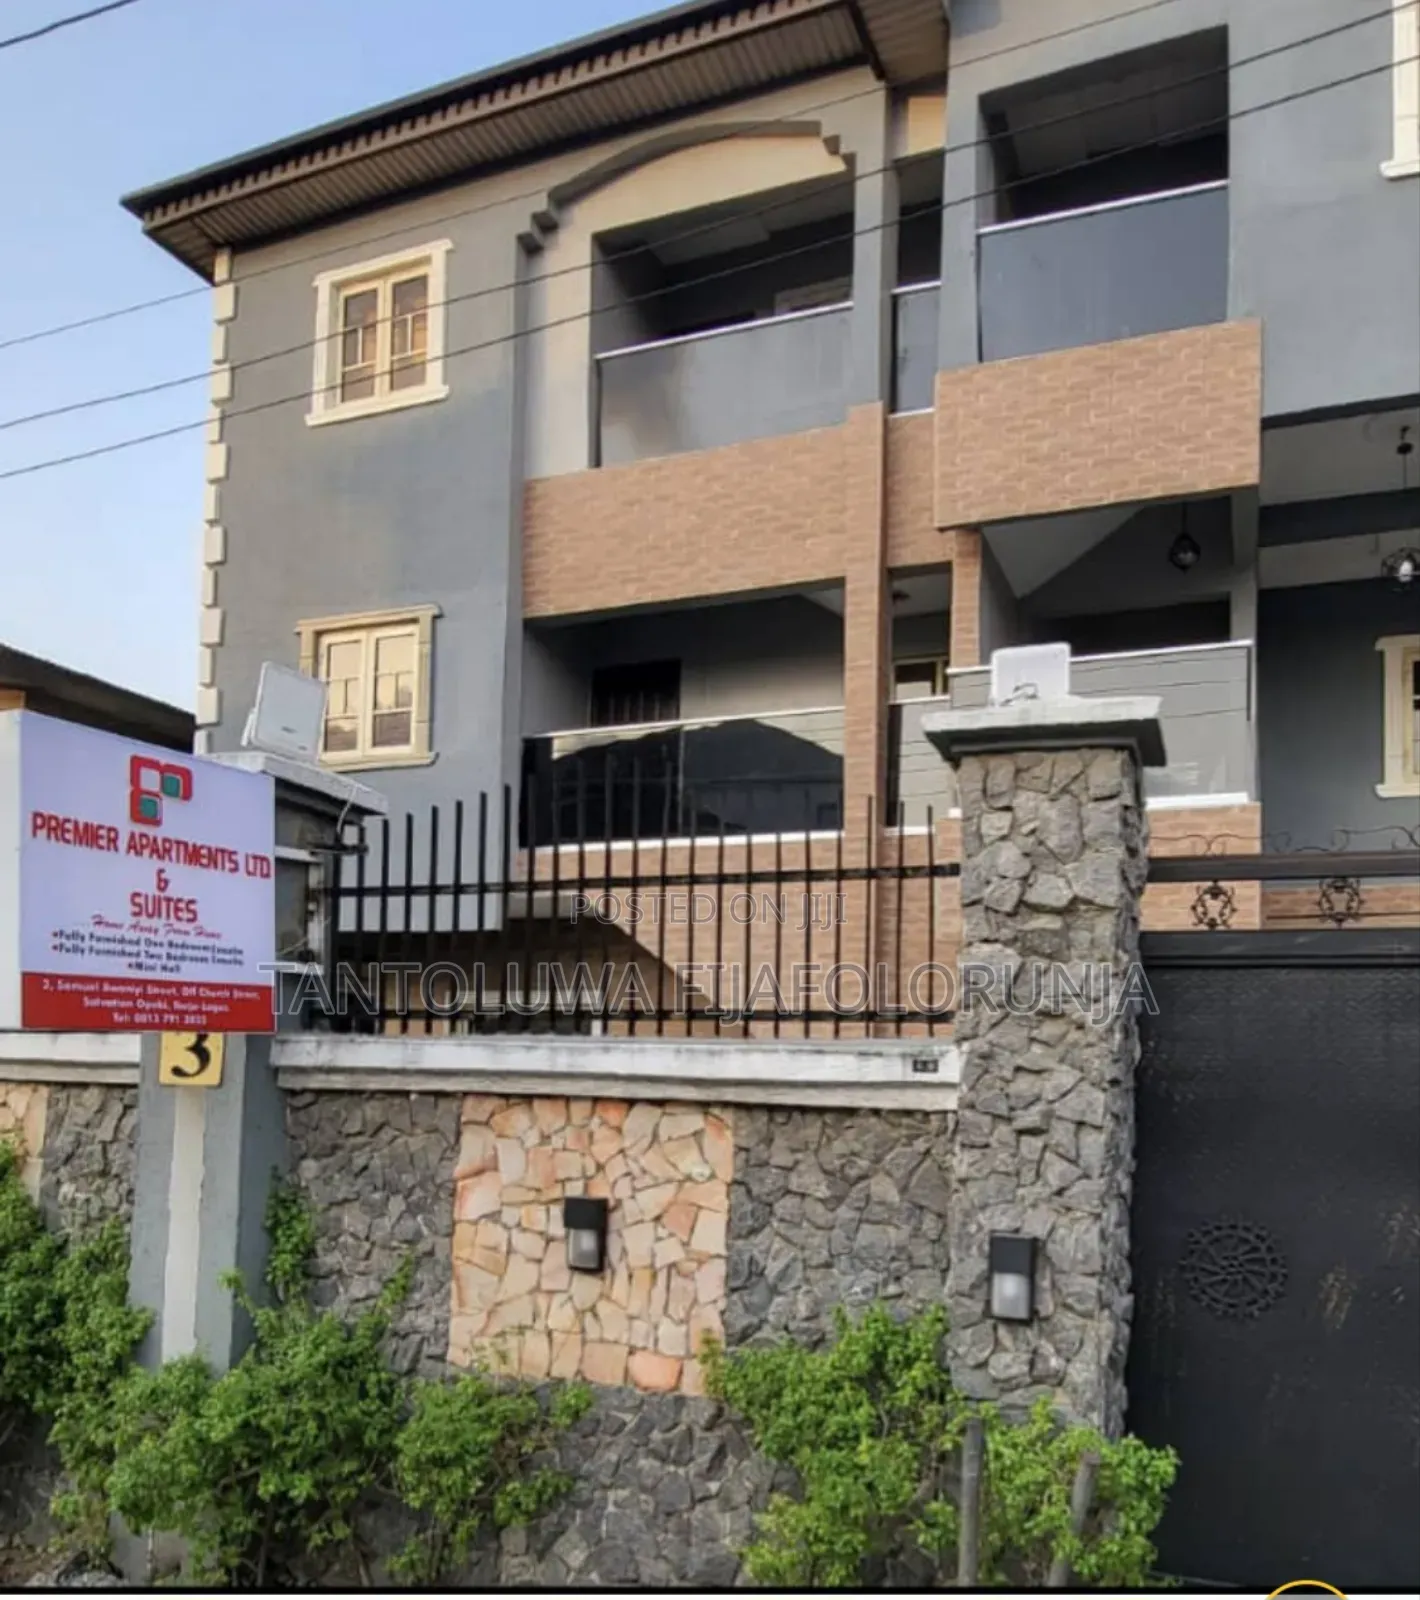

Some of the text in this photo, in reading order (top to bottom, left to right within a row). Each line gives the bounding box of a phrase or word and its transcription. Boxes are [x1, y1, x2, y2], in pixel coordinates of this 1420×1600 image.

[31, 811, 272, 879] PREMIER APARTMENTS LTD
[156, 869, 169, 893] &
[130, 892, 198, 924] SUITES
[171, 1032, 211, 1078] 3
